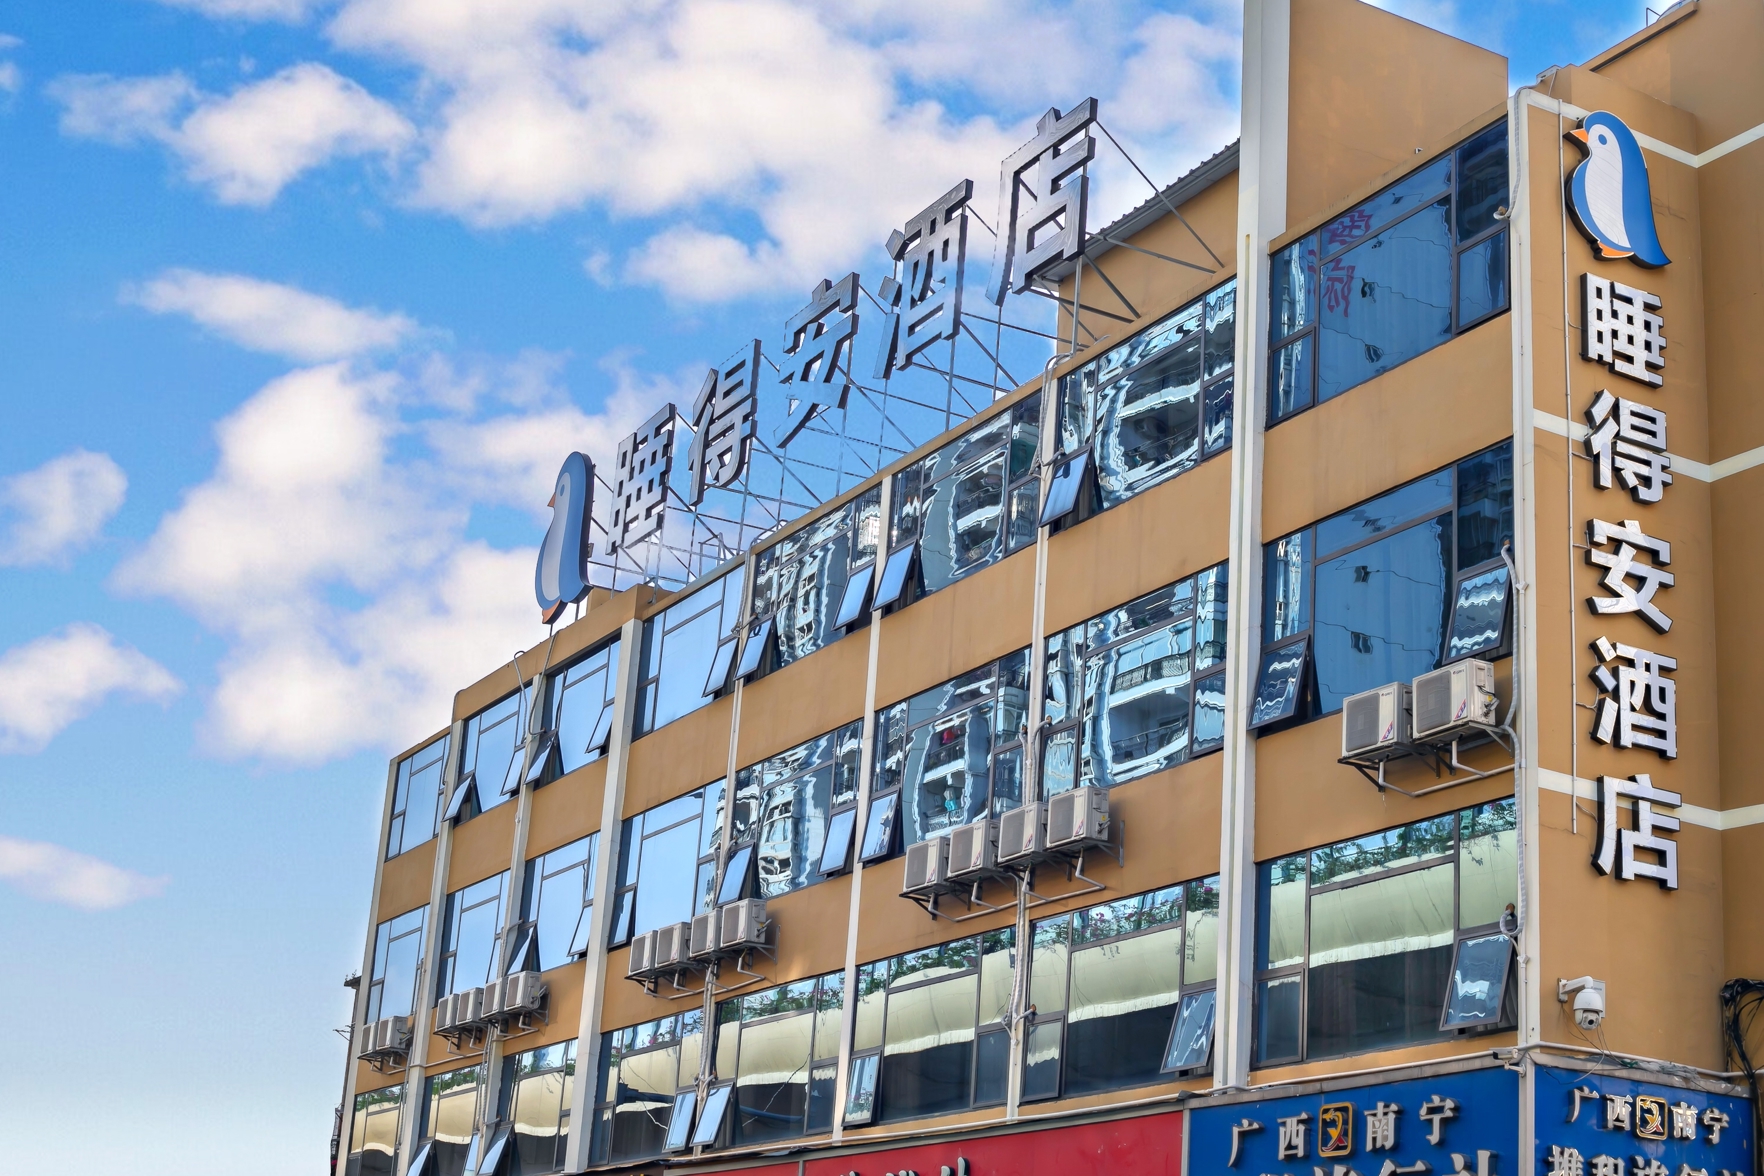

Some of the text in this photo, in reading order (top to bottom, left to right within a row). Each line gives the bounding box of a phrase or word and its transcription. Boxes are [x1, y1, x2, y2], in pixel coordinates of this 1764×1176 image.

[605, 97, 1098, 556] 睡得安酒店
[1580, 272, 1682, 891] 睡得安酒店
